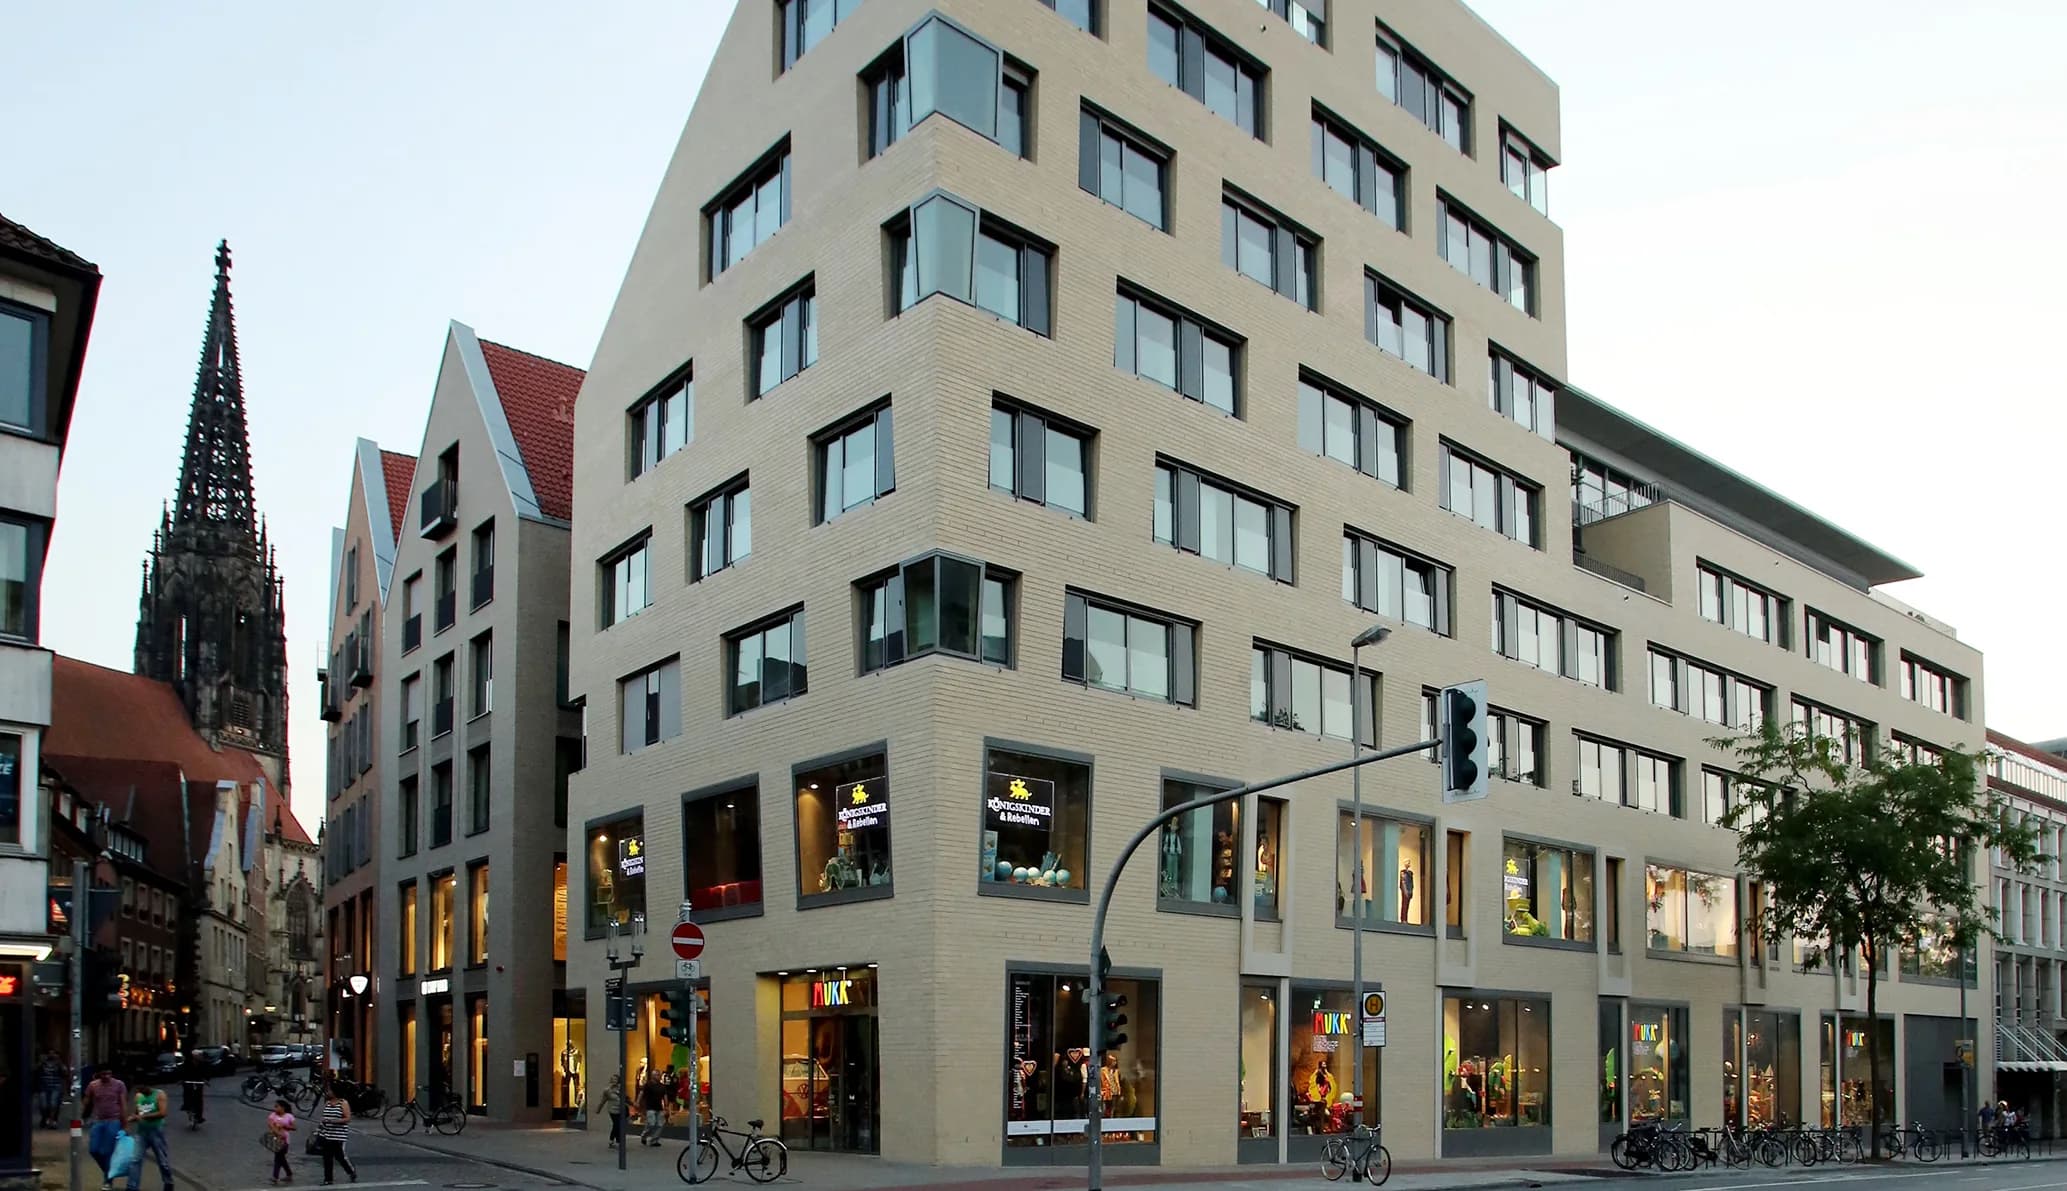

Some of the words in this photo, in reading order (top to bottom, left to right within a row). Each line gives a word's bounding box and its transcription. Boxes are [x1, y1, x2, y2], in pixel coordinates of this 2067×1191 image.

[988, 796, 1051, 816] KÖNIGSKINDER
[1000, 811, 1006, 821] &
[1007, 812, 1039, 826] Rebellen
[813, 980, 849, 1006] MUKK
[1370, 998, 1378, 1011] H
[1314, 1012, 1349, 1034] MUKK
